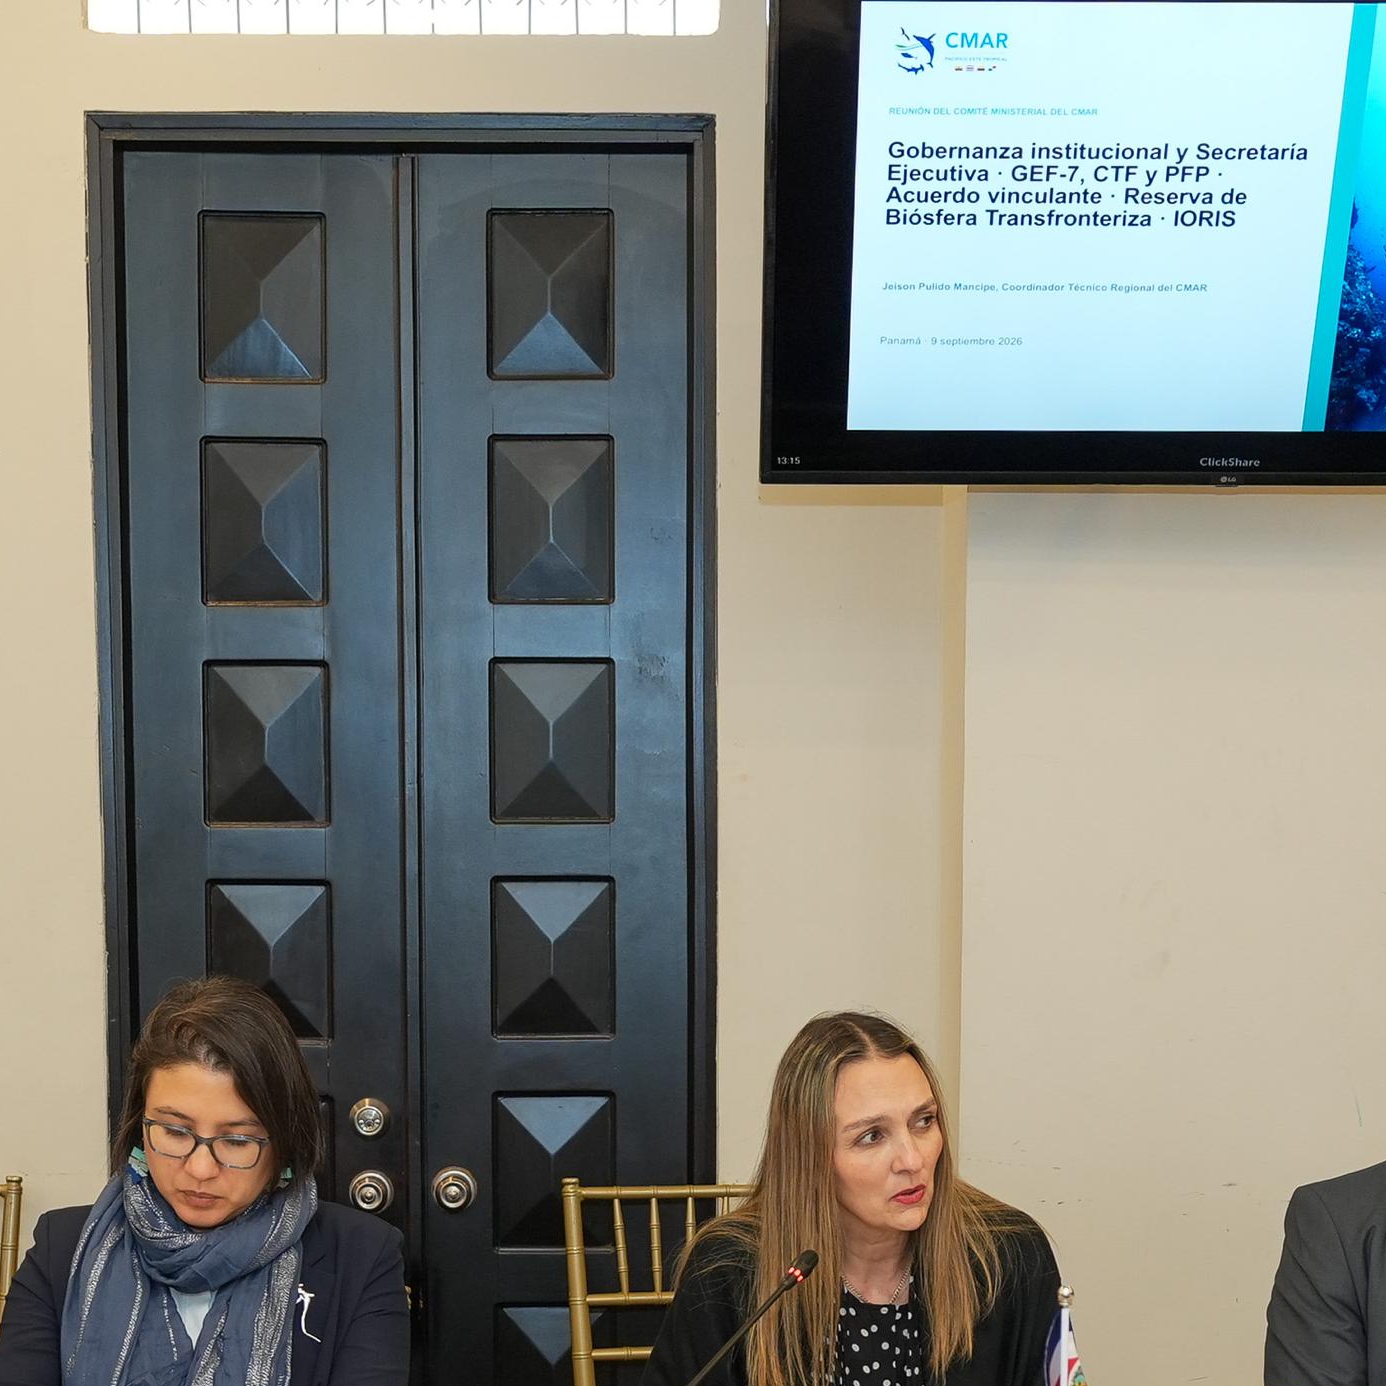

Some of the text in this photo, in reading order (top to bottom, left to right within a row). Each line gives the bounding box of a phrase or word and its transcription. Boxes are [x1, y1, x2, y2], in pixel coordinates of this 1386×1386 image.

[945, 32, 1008, 48] CMAR
[888, 106, 1098, 116] REUNIÓN DEL COMITÉ MINISTERIAL DEL CMAR
[888, 141, 1308, 164] Gobernanza institucional y Secretaría
[887, 164, 1210, 187] Ejecutiva GEF-7, CTF y PFP
[886, 186, 1247, 204] Acuerdo vinculante Reserva de
[885, 208, 1236, 227] Biósfera Transfronteriza IORIS
[882, 282, 1208, 293] Jeison Pulido Mancipe, Coordinador Técnico Regional del CMAR
[880, 336, 921, 345] Panamá
[931, 337, 937, 345] 9
[940, 337, 995, 346] septiembre
[777, 456, 801, 465] 13:15
[1199, 457, 1261, 467] ClickShare
